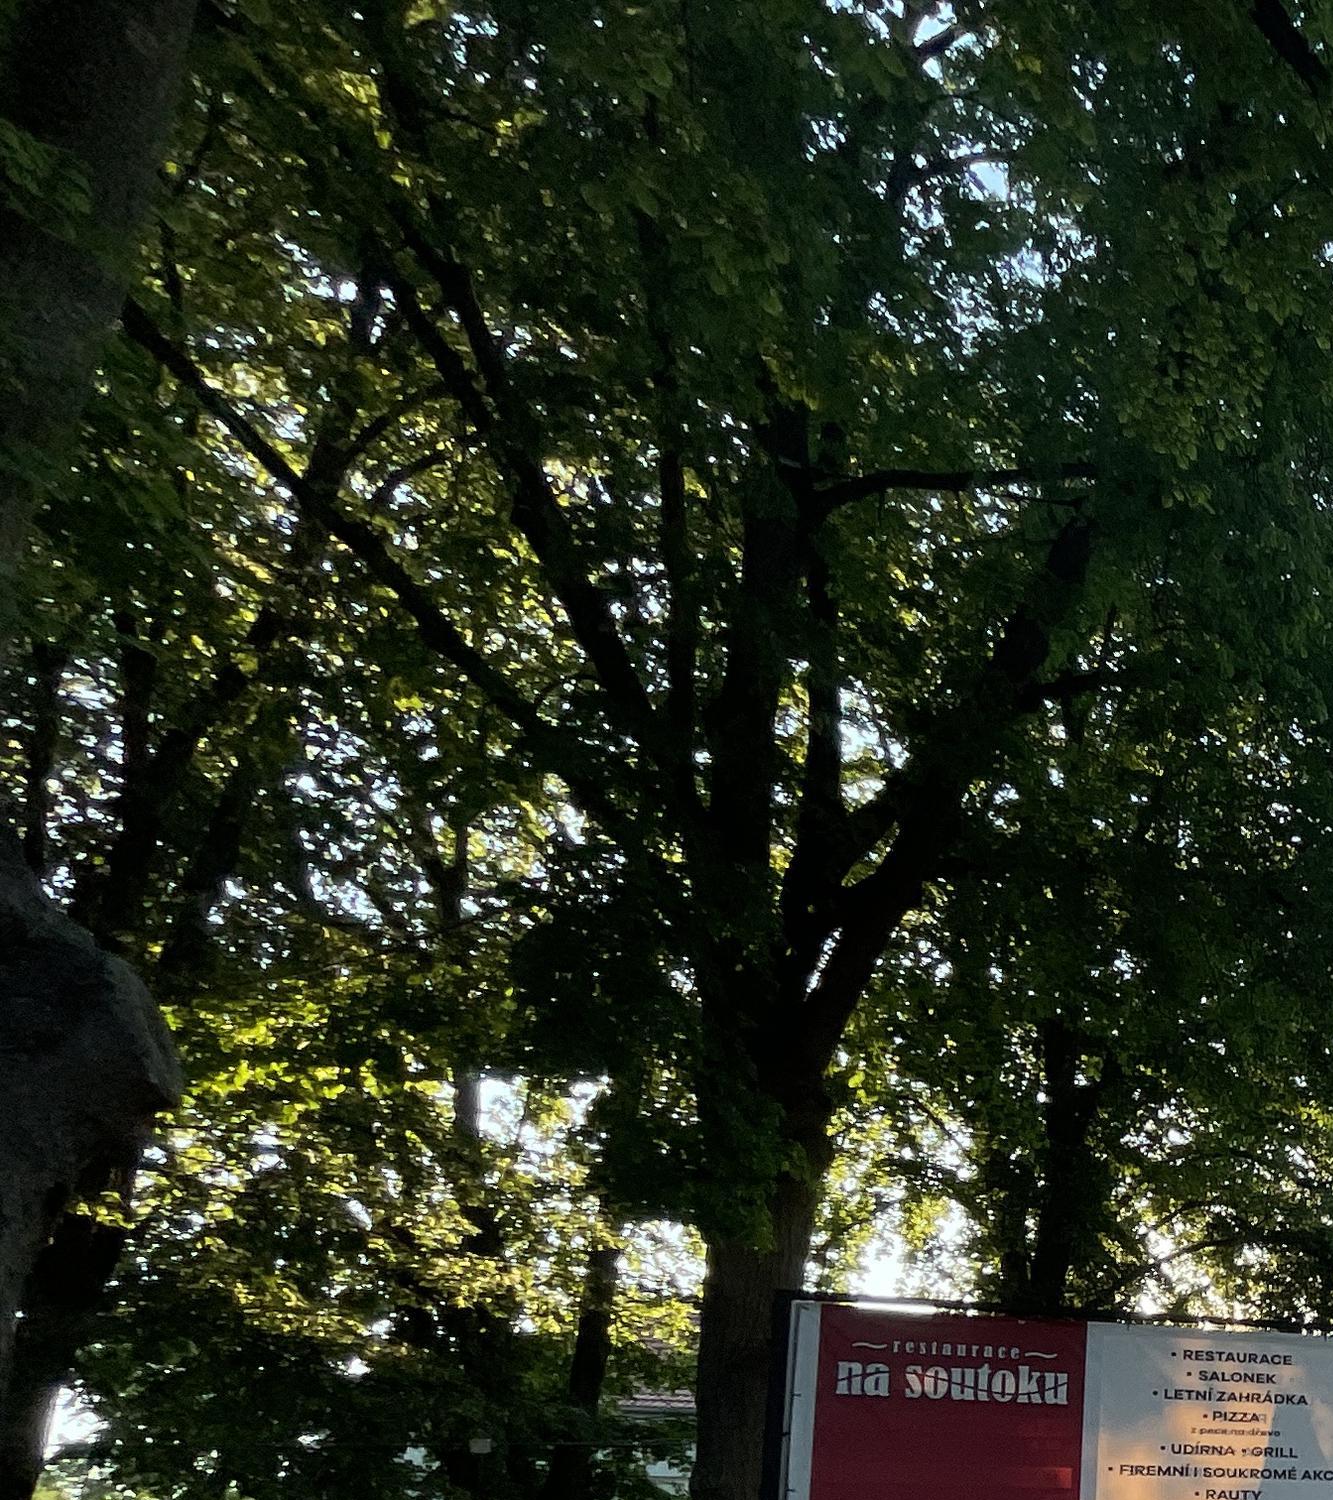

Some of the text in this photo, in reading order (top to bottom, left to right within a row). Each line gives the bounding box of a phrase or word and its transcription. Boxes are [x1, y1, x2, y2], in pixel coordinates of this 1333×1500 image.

[893, 1341, 1020, 1359] restaurace
[1183, 1350, 1293, 1366] RESTAURACE
[836, 1361, 1069, 1405] na soutoku
[1198, 1370, 1277, 1385] SALONEK
[1163, 1387, 1309, 1406] LETNÍ ZAHRÁDKA
[1212, 1410, 1261, 1423] PIZZA
[1170, 1441, 1299, 1459] UDÍRNA GRILL
[1119, 1463, 1190, 1478] FIREMNÍ
[1202, 1466, 1298, 1481] SOUKROMÉ
[1205, 1489, 1263, 1500] RAUTY
